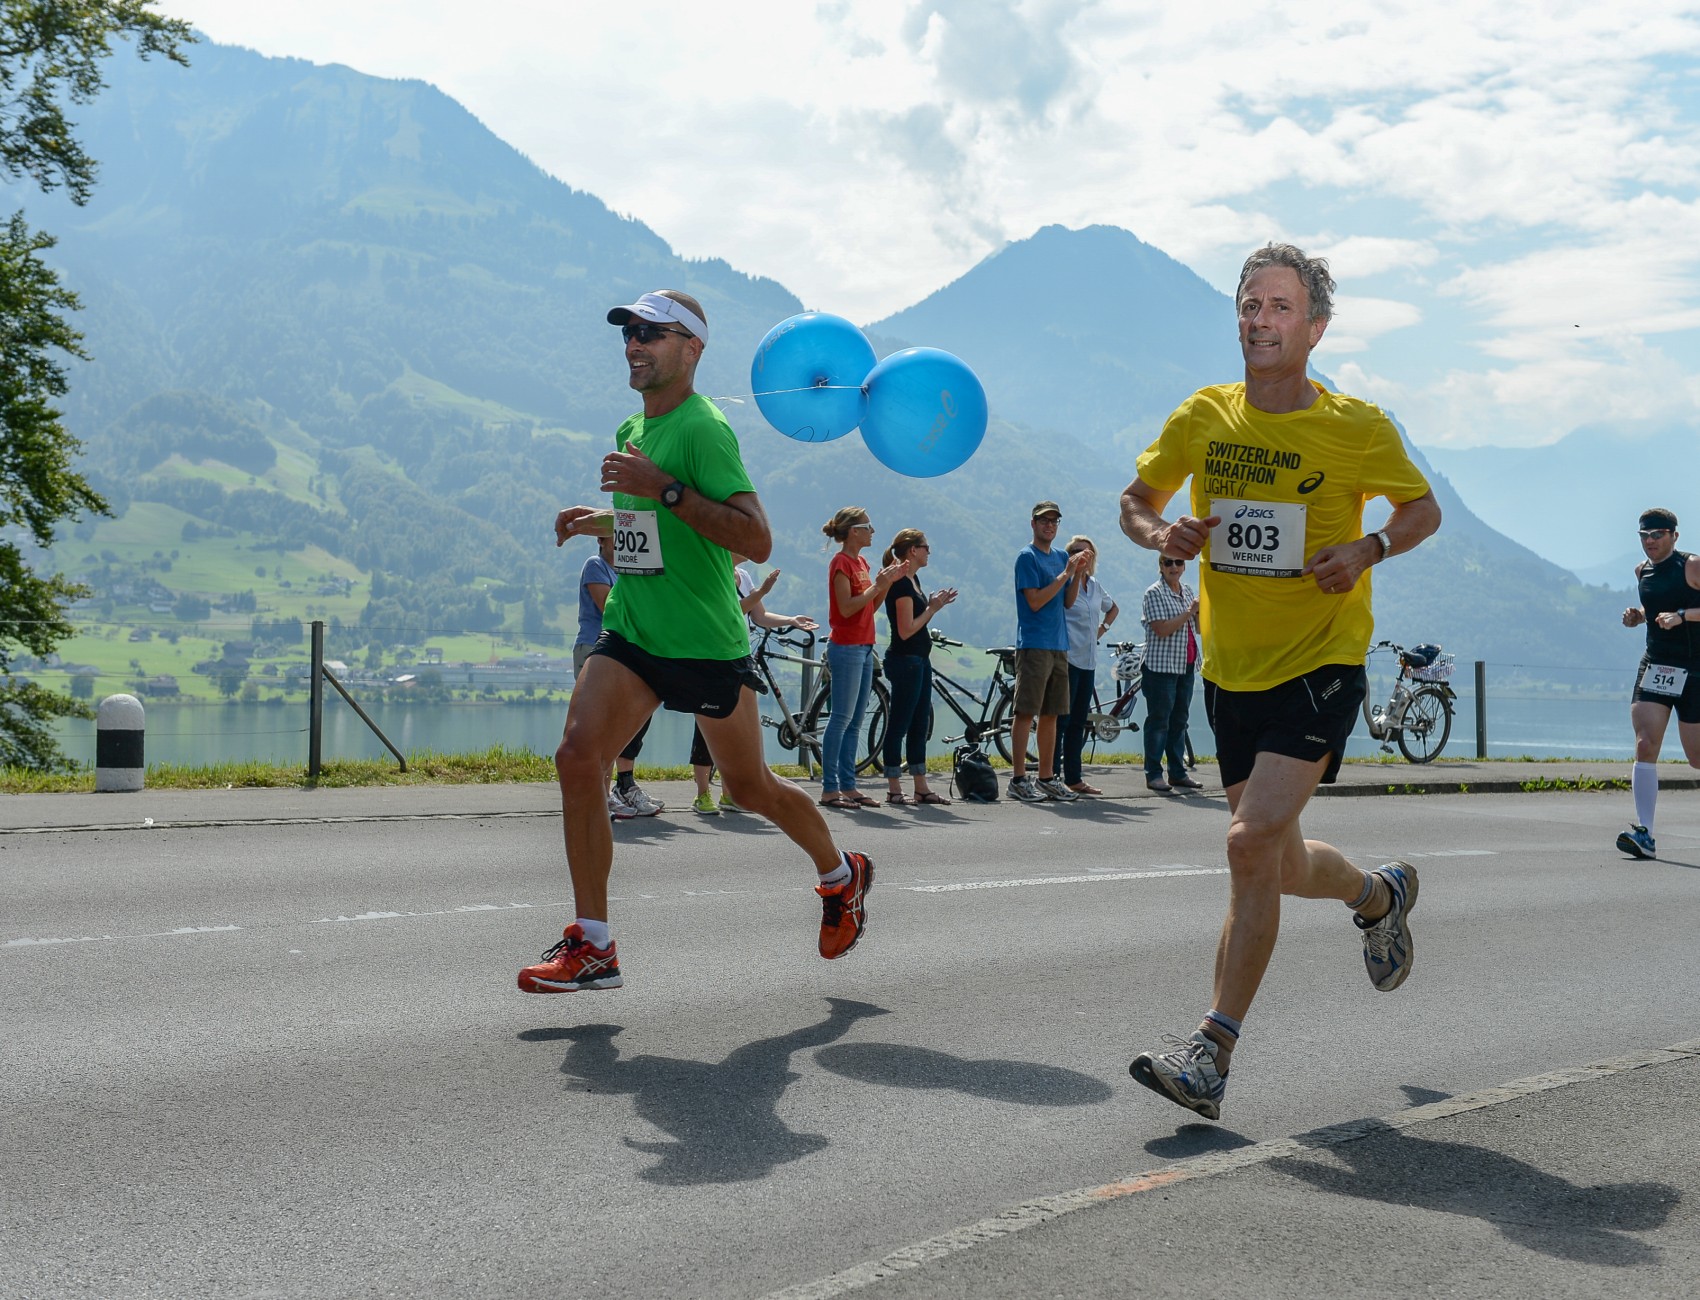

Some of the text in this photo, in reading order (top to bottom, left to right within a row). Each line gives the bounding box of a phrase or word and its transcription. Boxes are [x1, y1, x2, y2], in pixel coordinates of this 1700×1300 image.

[1206, 441, 1301, 470] SWITZERLAND
[1205, 458, 1277, 485] MARATHON
[1247, 508, 1275, 519] asics
[1227, 523, 1280, 551] 803
[617, 554, 638, 563] ANDRÉ
[1232, 551, 1274, 563] WERNER
[1216, 564, 1247, 575] SWITZERLAND
[1247, 568, 1276, 577] MARATHON
[1652, 674, 1675, 686] 514
